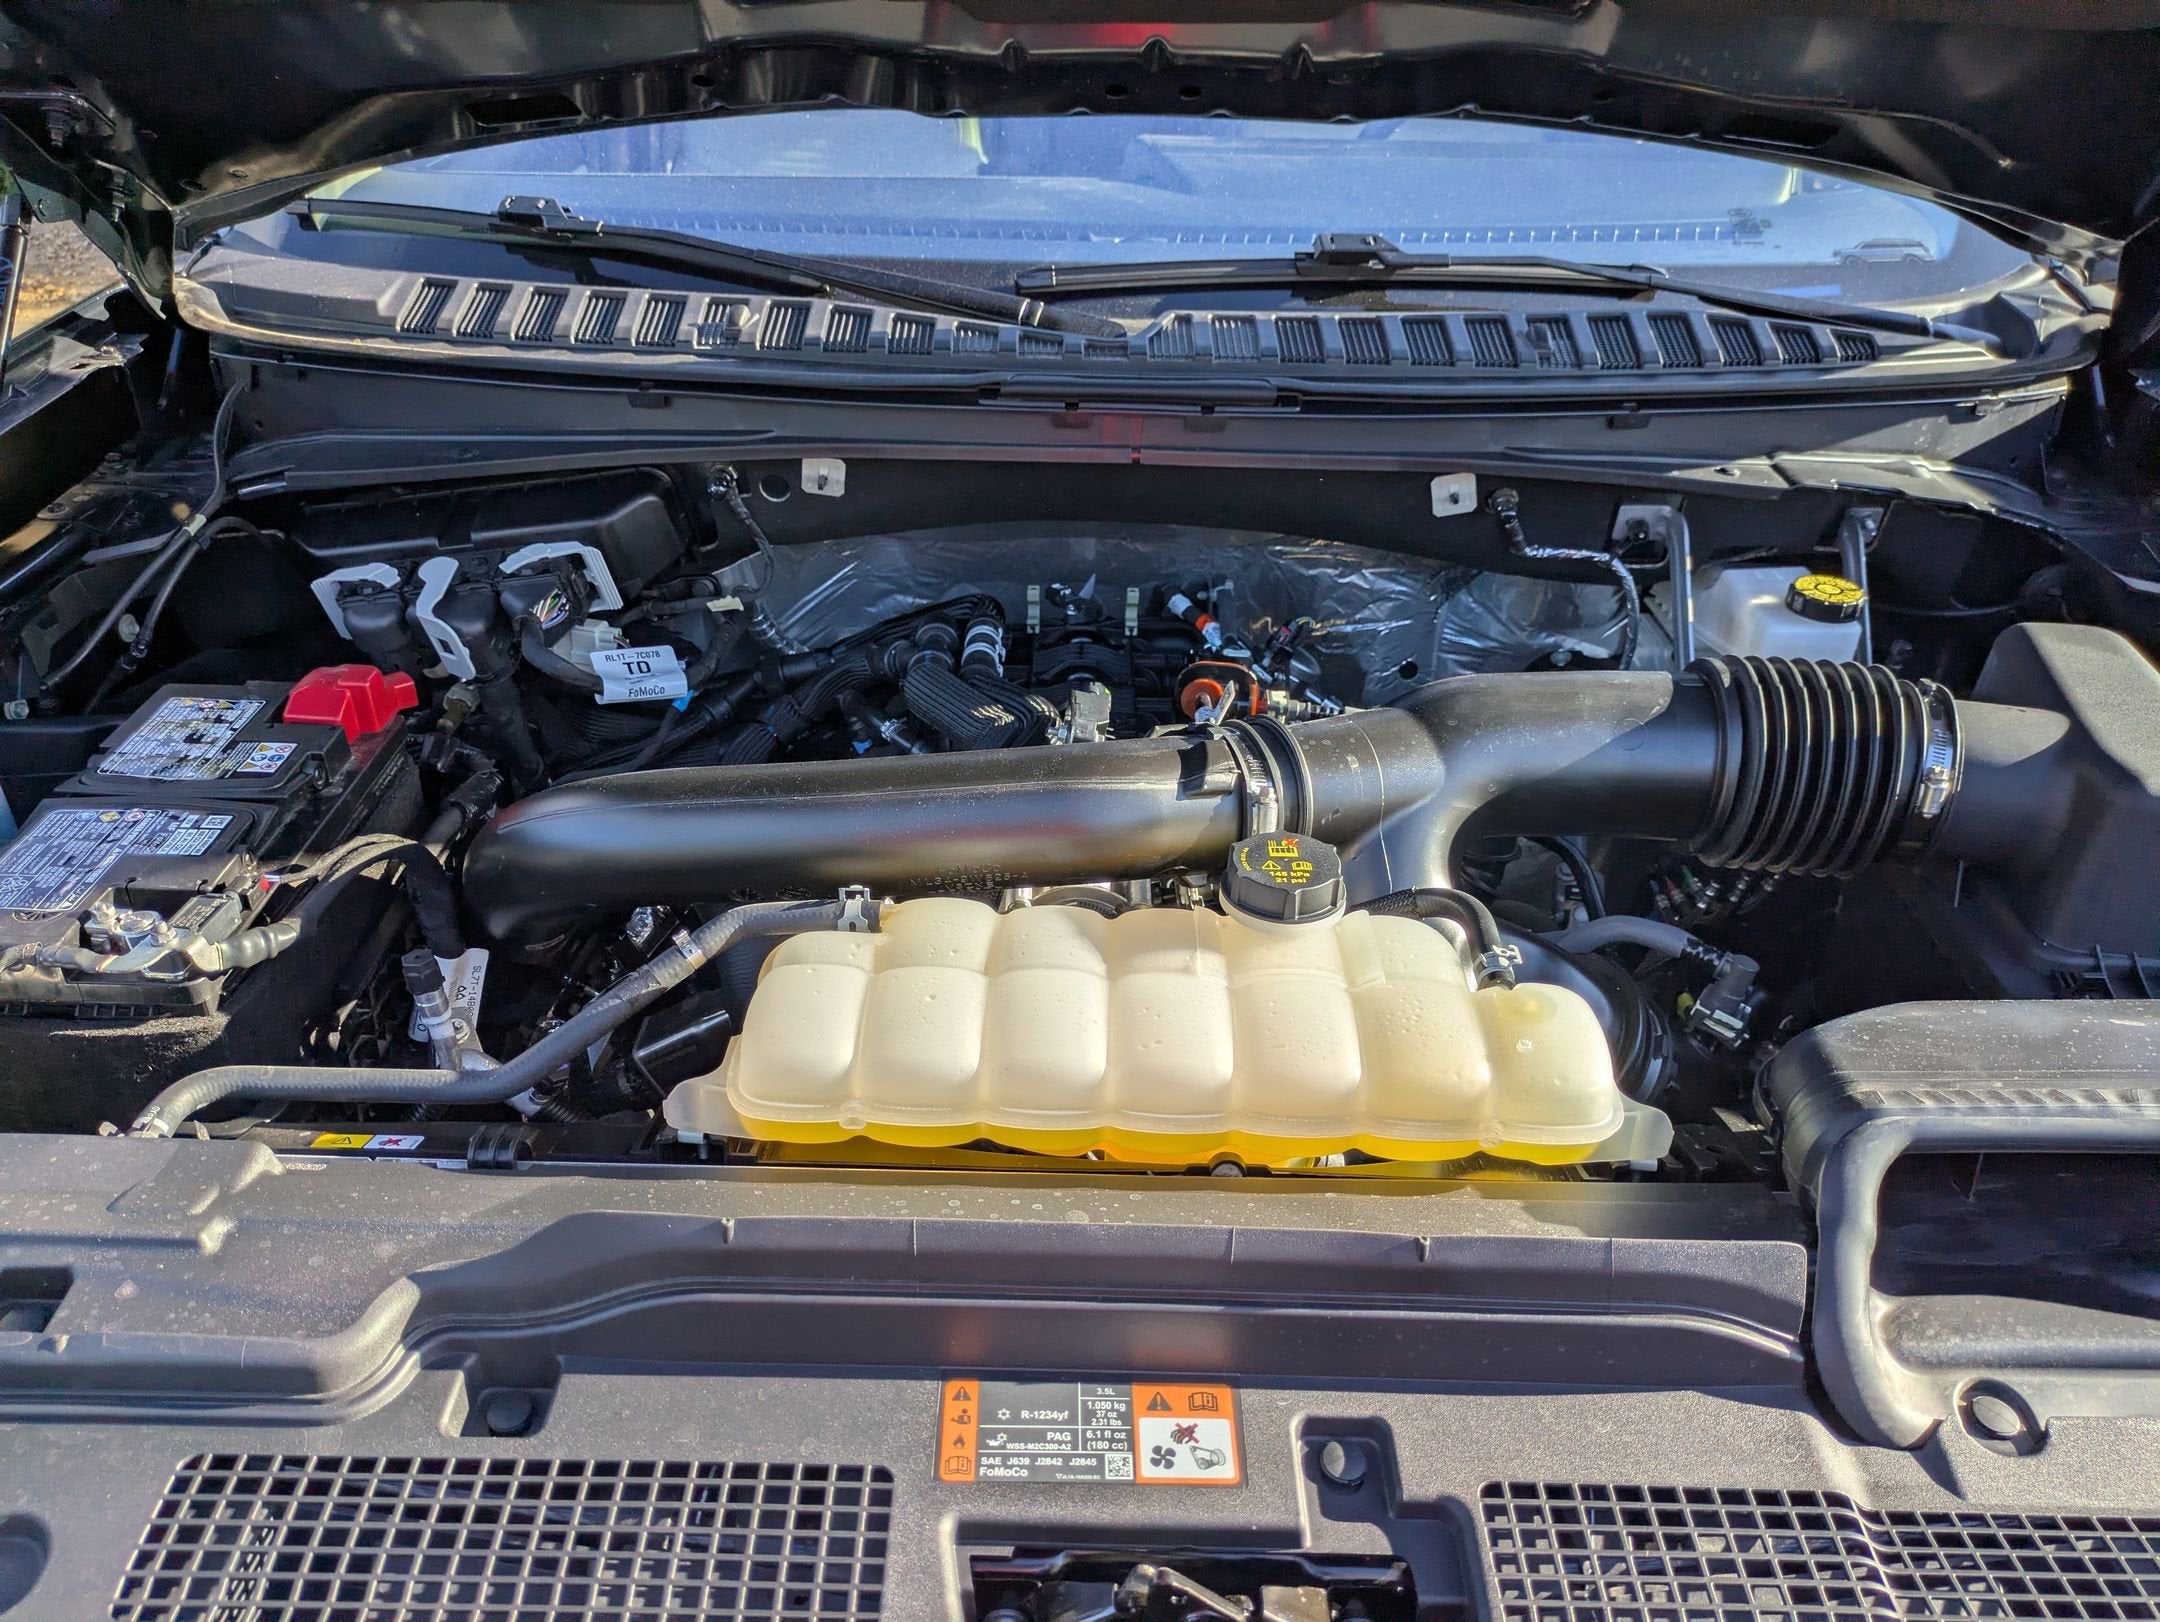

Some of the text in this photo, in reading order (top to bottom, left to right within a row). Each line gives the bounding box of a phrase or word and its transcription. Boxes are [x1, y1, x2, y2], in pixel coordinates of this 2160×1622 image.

[622, 660, 652, 675] TD
[628, 685, 665, 698] FoMoCo
[1096, 1387, 1116, 1395] 3.5L
[1087, 1400, 1126, 1412] 1.050 kg
[1021, 1410, 1069, 1421] R-1234yf
[1091, 1418, 1122, 1426] 2.31 lbs
[1046, 1431, 1072, 1441] PAG
[1086, 1430, 1127, 1439] 6.1 fl oz
[1087, 1441, 1128, 1451] (180 cc)
[980, 1456, 1097, 1466] SAE J639 J2842 J2845
[979, 1466, 1028, 1477] FoMoCo
